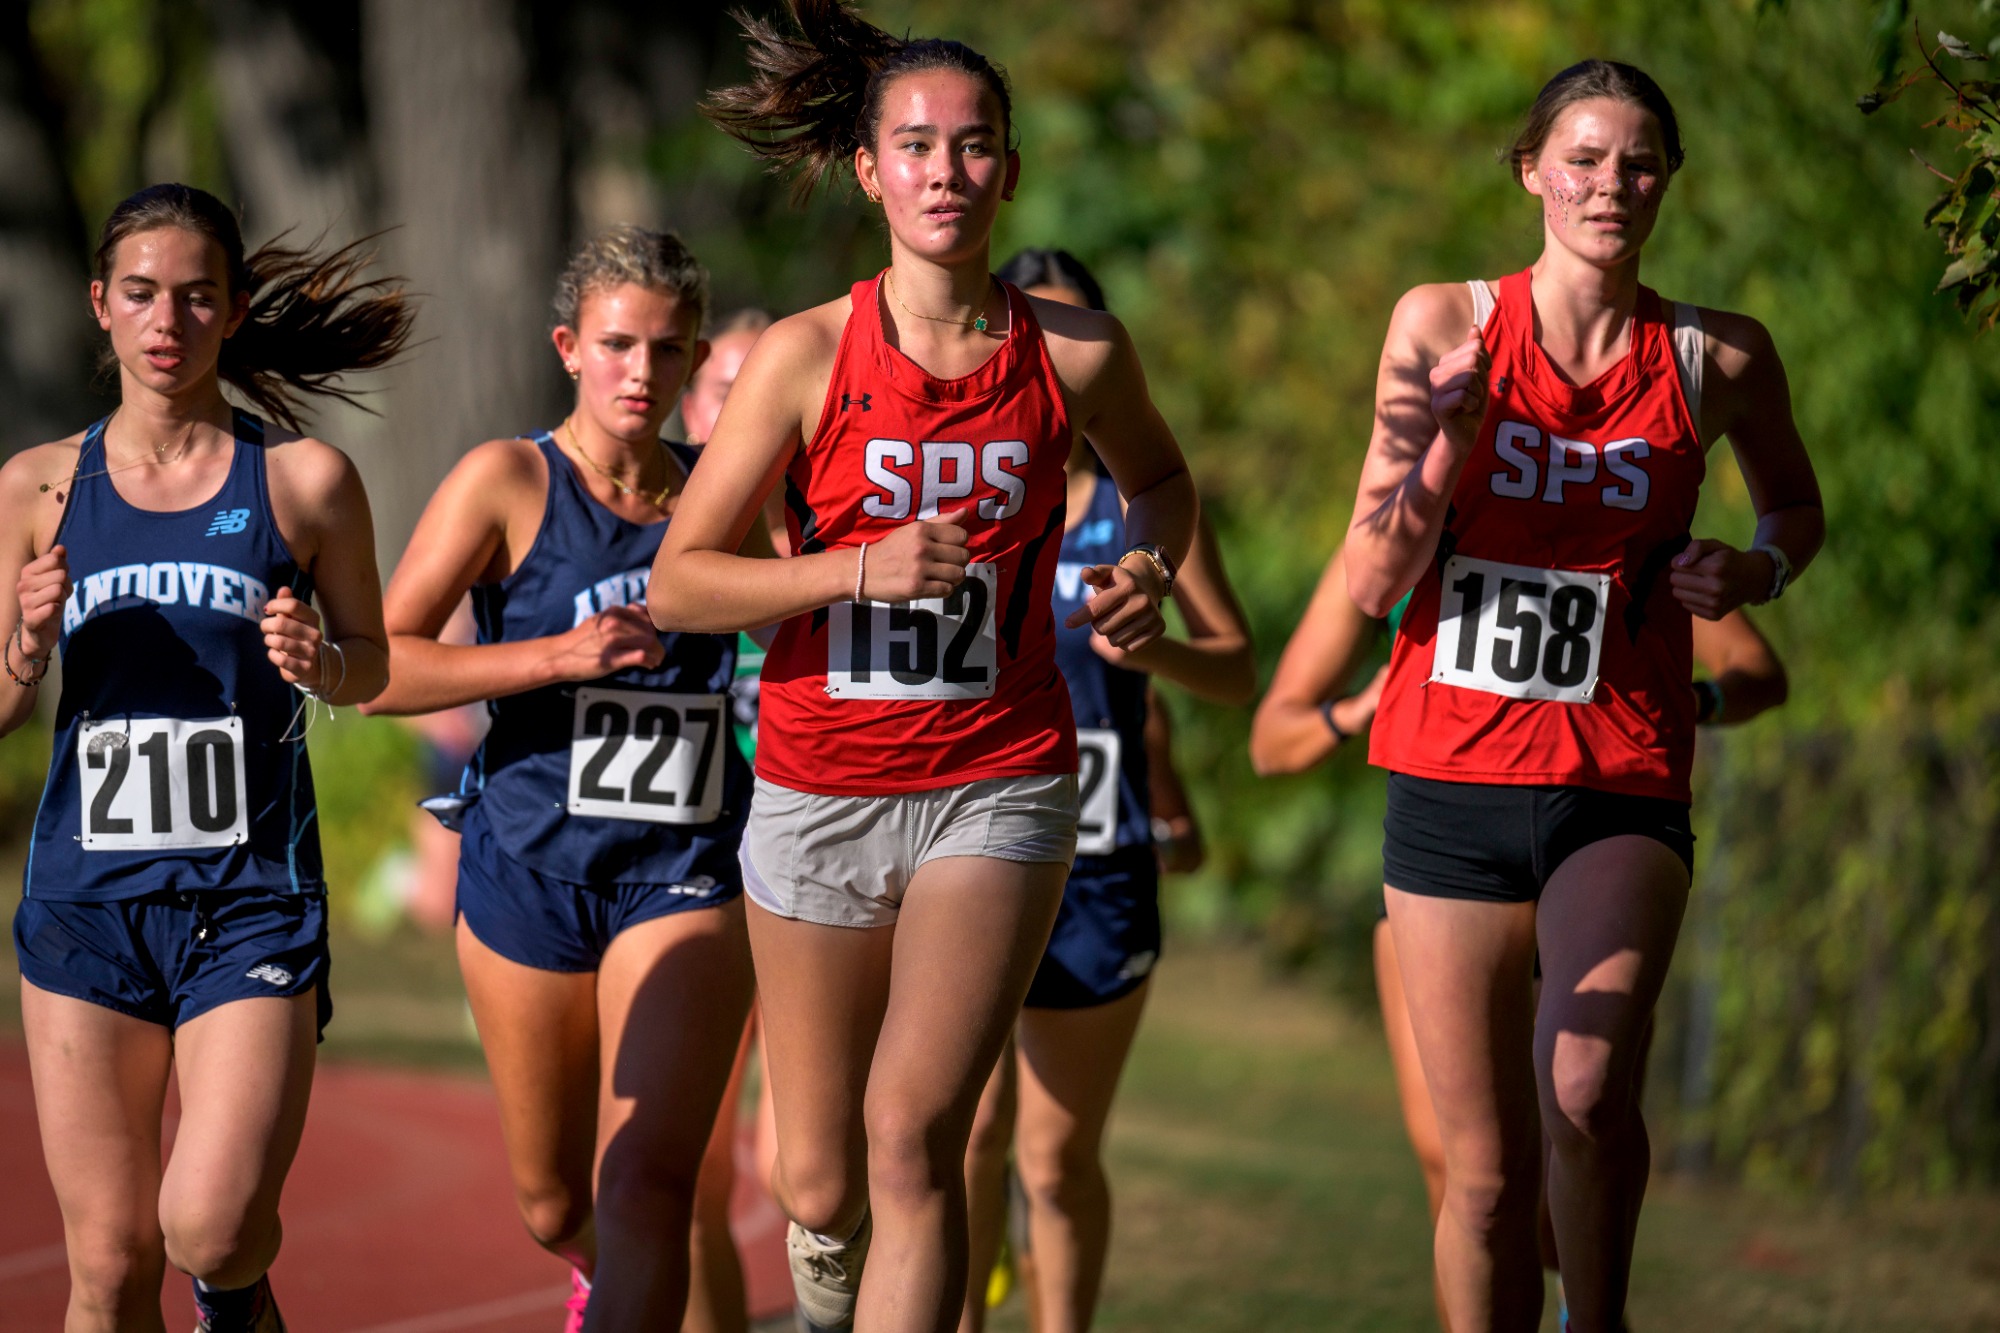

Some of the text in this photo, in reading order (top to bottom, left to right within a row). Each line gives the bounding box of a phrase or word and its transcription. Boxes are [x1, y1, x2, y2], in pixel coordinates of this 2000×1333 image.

[861, 438, 1030, 521] SPS
[1490, 420, 1652, 512] SPS
[62, 562, 269, 638] ANDOVER
[850, 576, 988, 686] 152
[1452, 571, 1598, 688] 158
[86, 728, 240, 836] 210
[579, 701, 720, 807] 227
